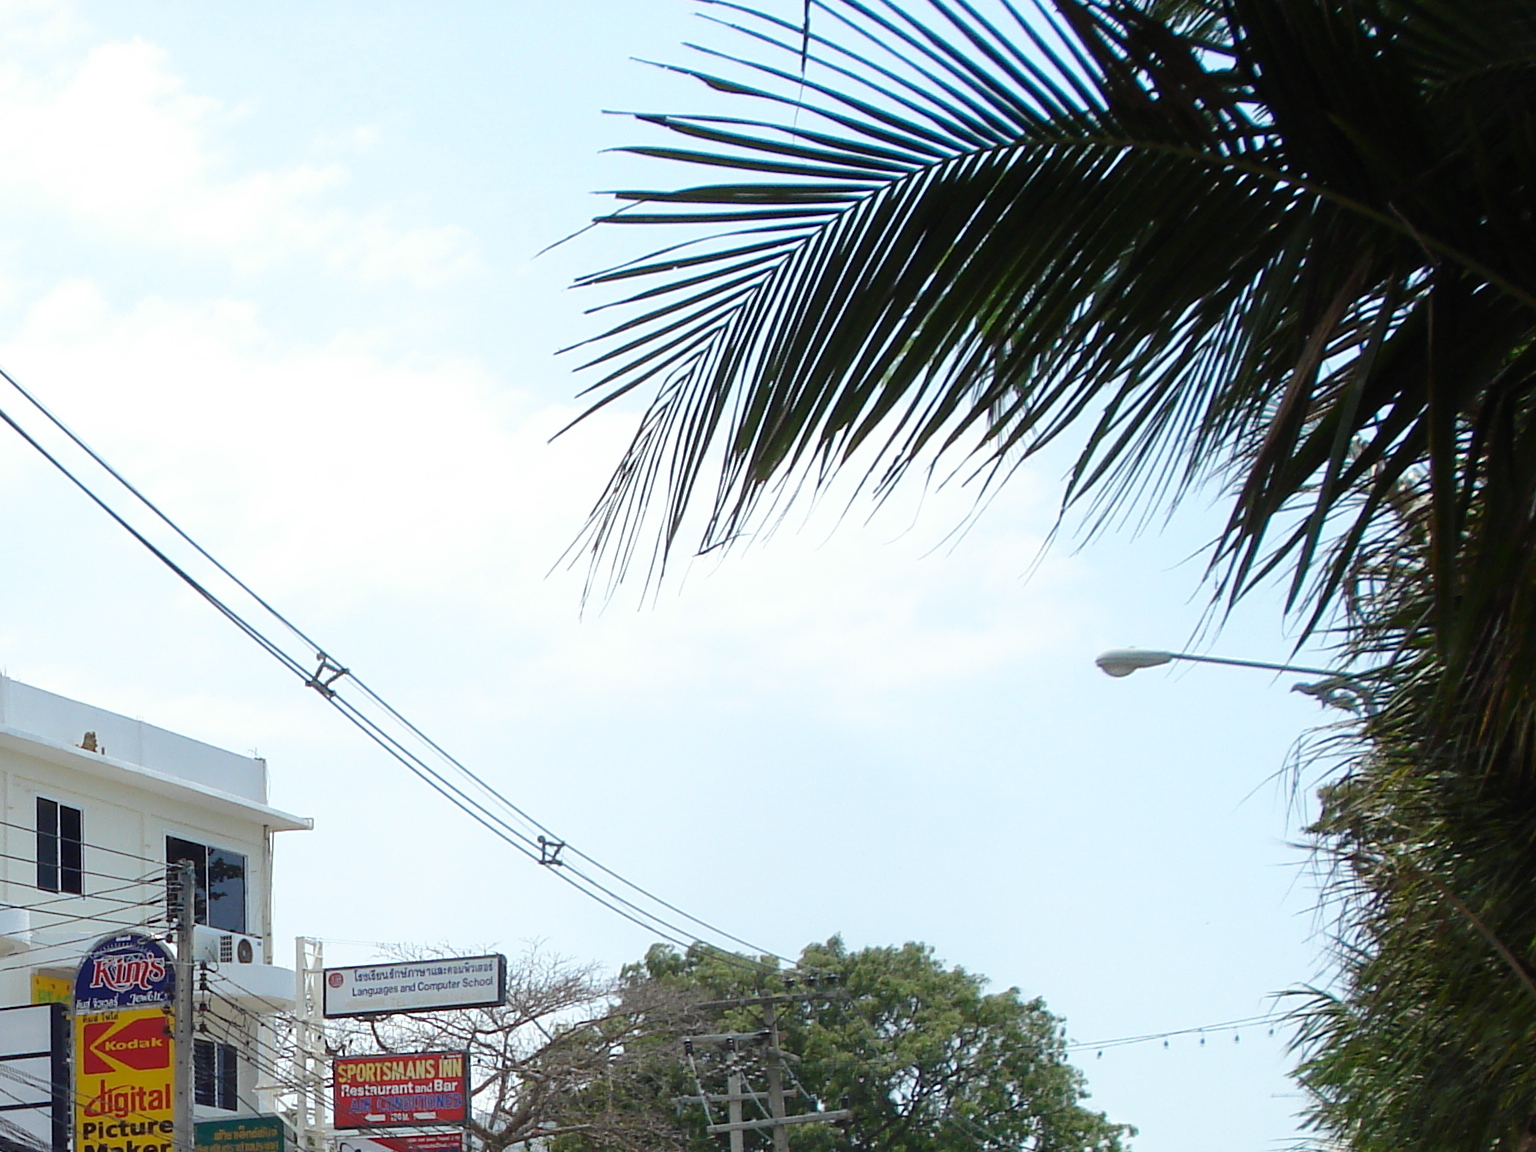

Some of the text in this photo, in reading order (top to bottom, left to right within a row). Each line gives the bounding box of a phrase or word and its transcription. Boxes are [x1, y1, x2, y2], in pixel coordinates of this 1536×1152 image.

[89, 952, 165, 993] Kim's
[352, 976, 493, 998] Languages and Computer School
[104, 1037, 163, 1051] Kodak
[337, 1058, 462, 1084] SPORTSMANS INN
[84, 1079, 171, 1118] digital
[341, 1079, 459, 1098] Restaurant and Bar
[350, 1093, 462, 1115] AIR CONDITIONED
[83, 1119, 173, 1140] Picture
